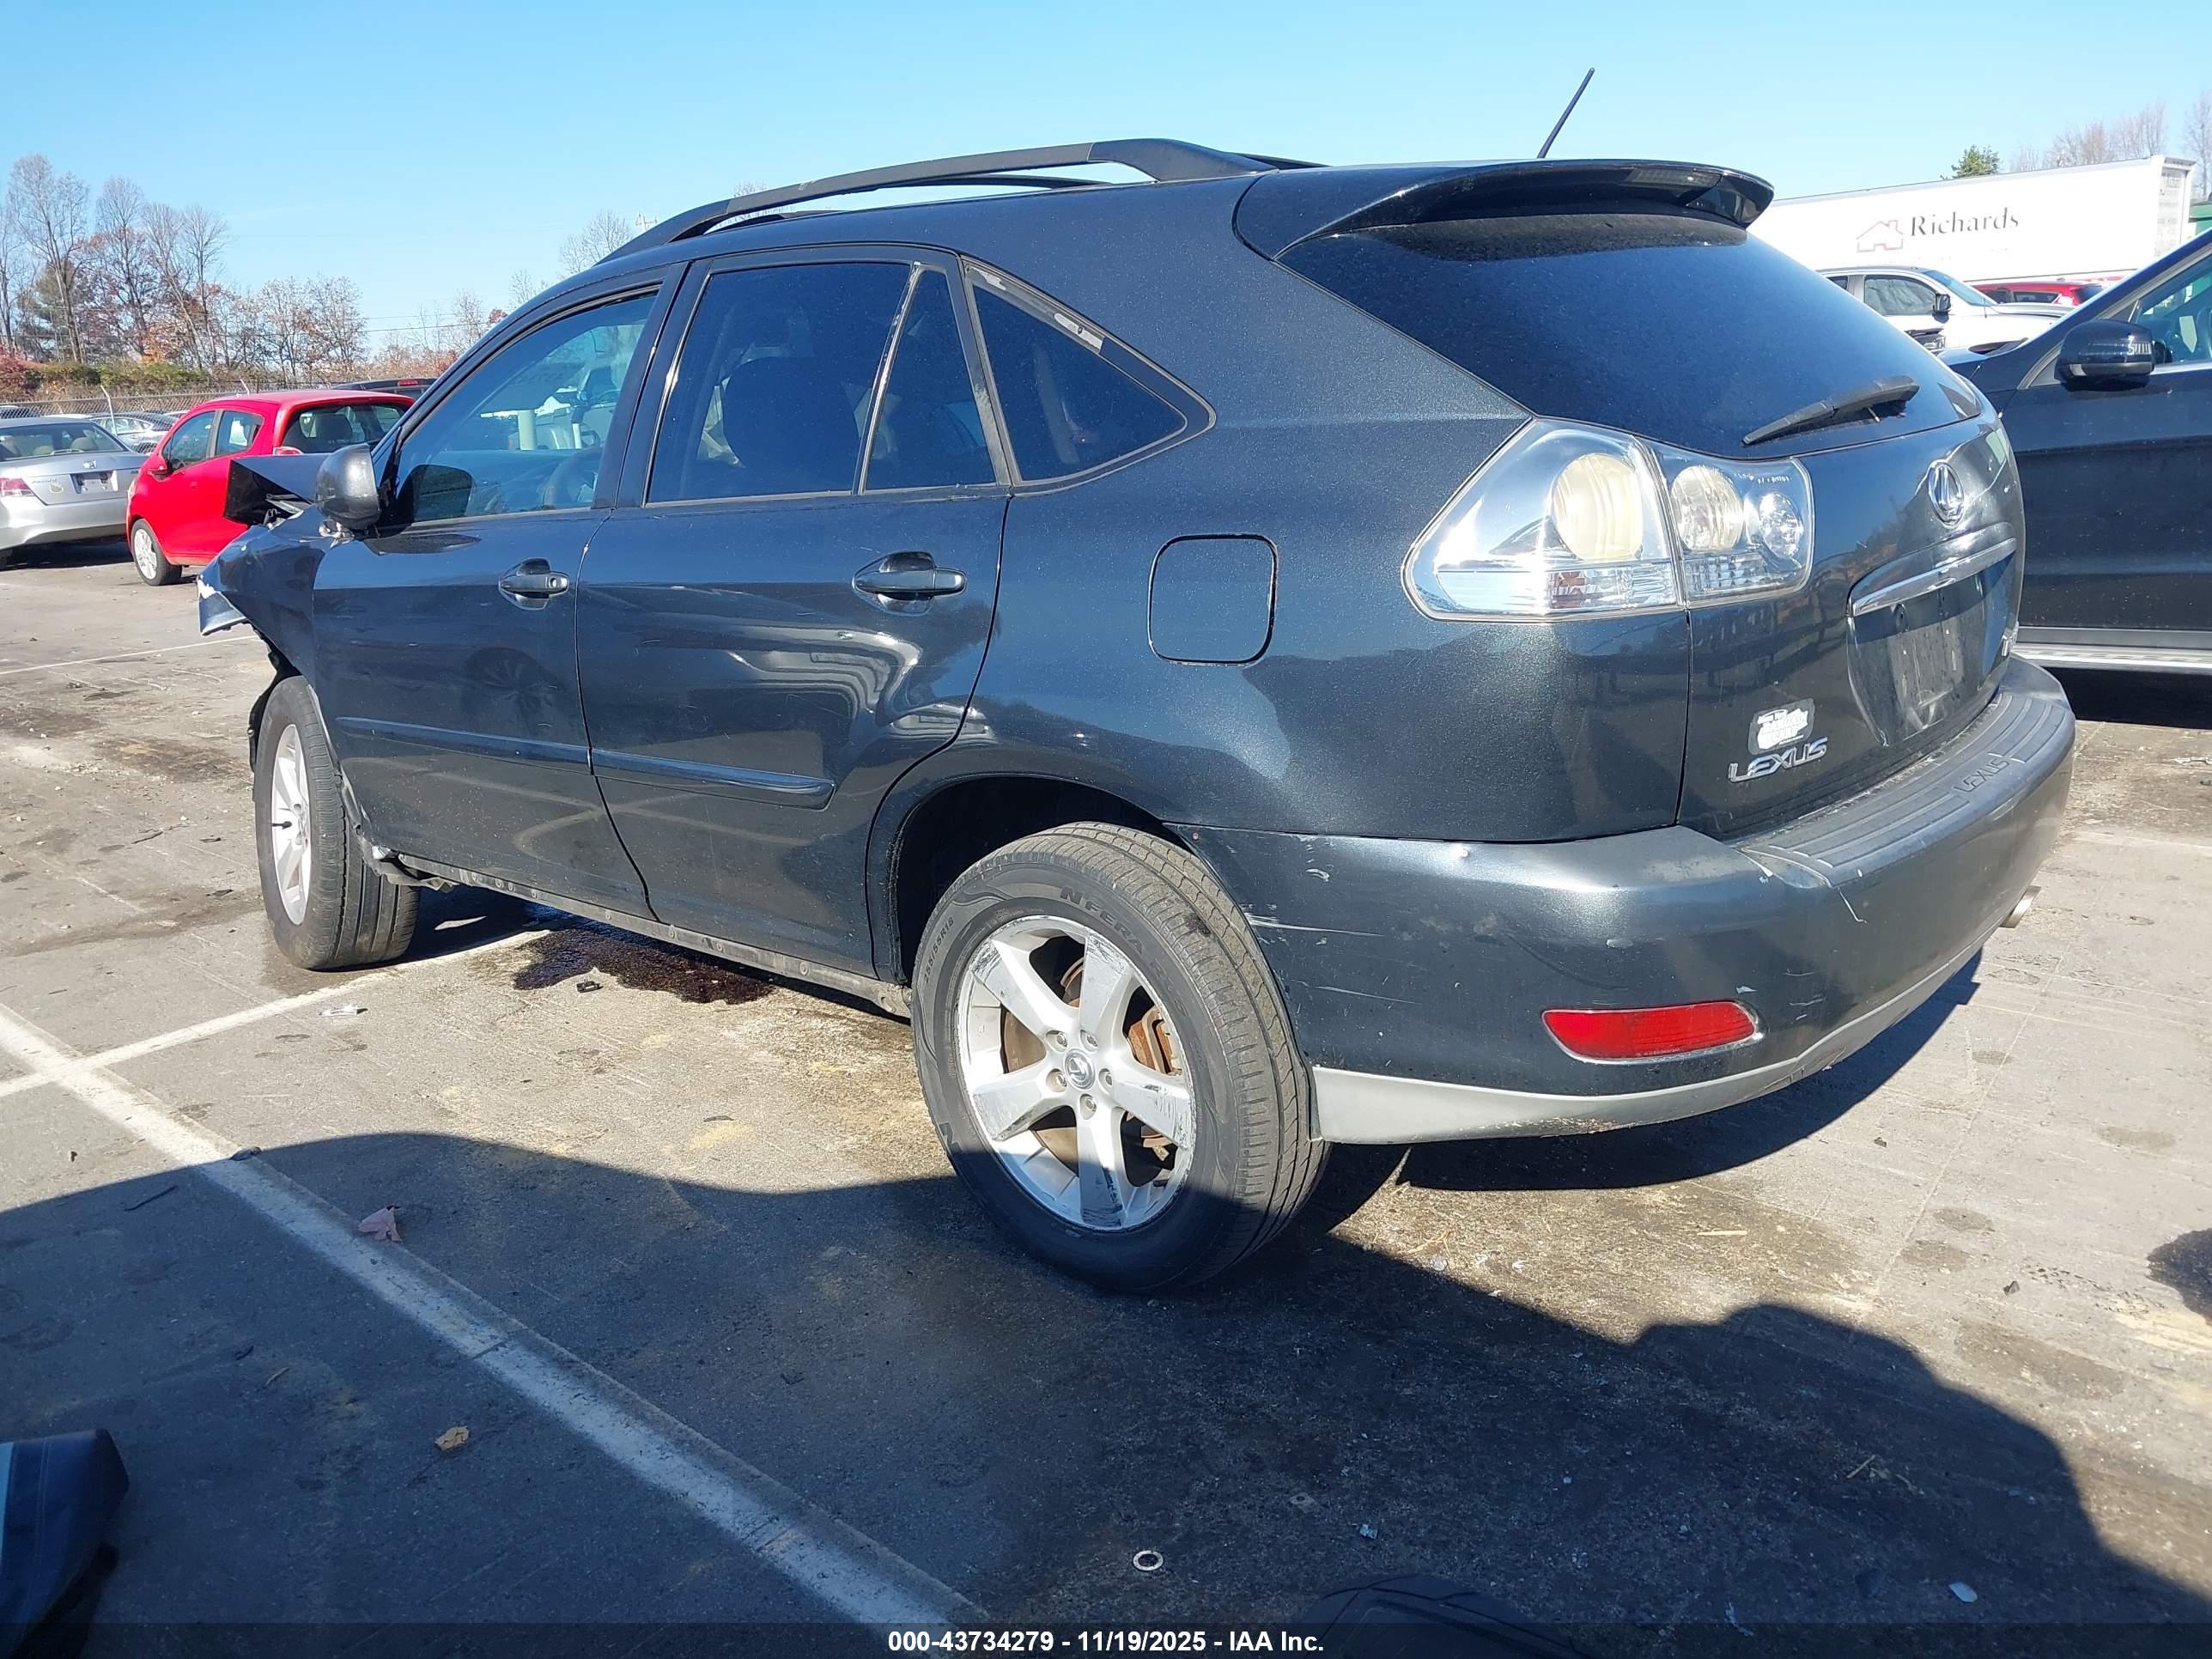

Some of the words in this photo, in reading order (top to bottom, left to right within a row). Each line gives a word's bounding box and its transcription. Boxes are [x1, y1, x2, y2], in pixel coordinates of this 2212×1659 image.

[1911, 206, 2019, 236] Richards
[1728, 737, 1828, 783] LEXUS
[1953, 758, 2010, 793] LEXUS
